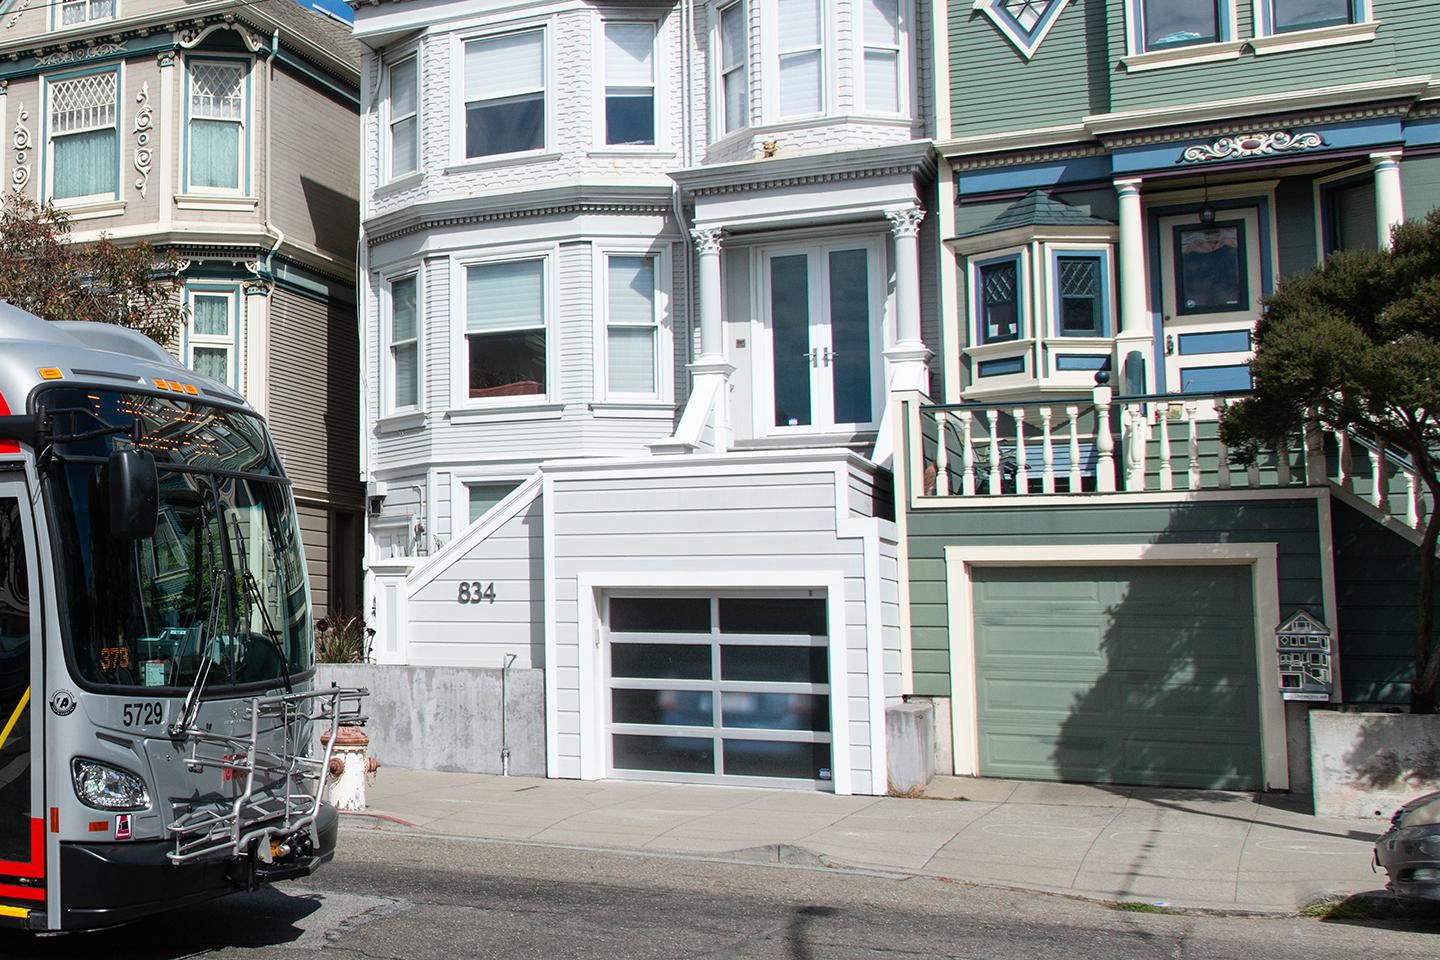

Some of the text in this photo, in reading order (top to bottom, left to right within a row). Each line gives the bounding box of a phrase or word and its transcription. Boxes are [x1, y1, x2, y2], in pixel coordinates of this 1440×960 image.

[457, 582, 497, 605] 834
[101, 646, 129, 671] 373
[123, 702, 163, 728] 5729
